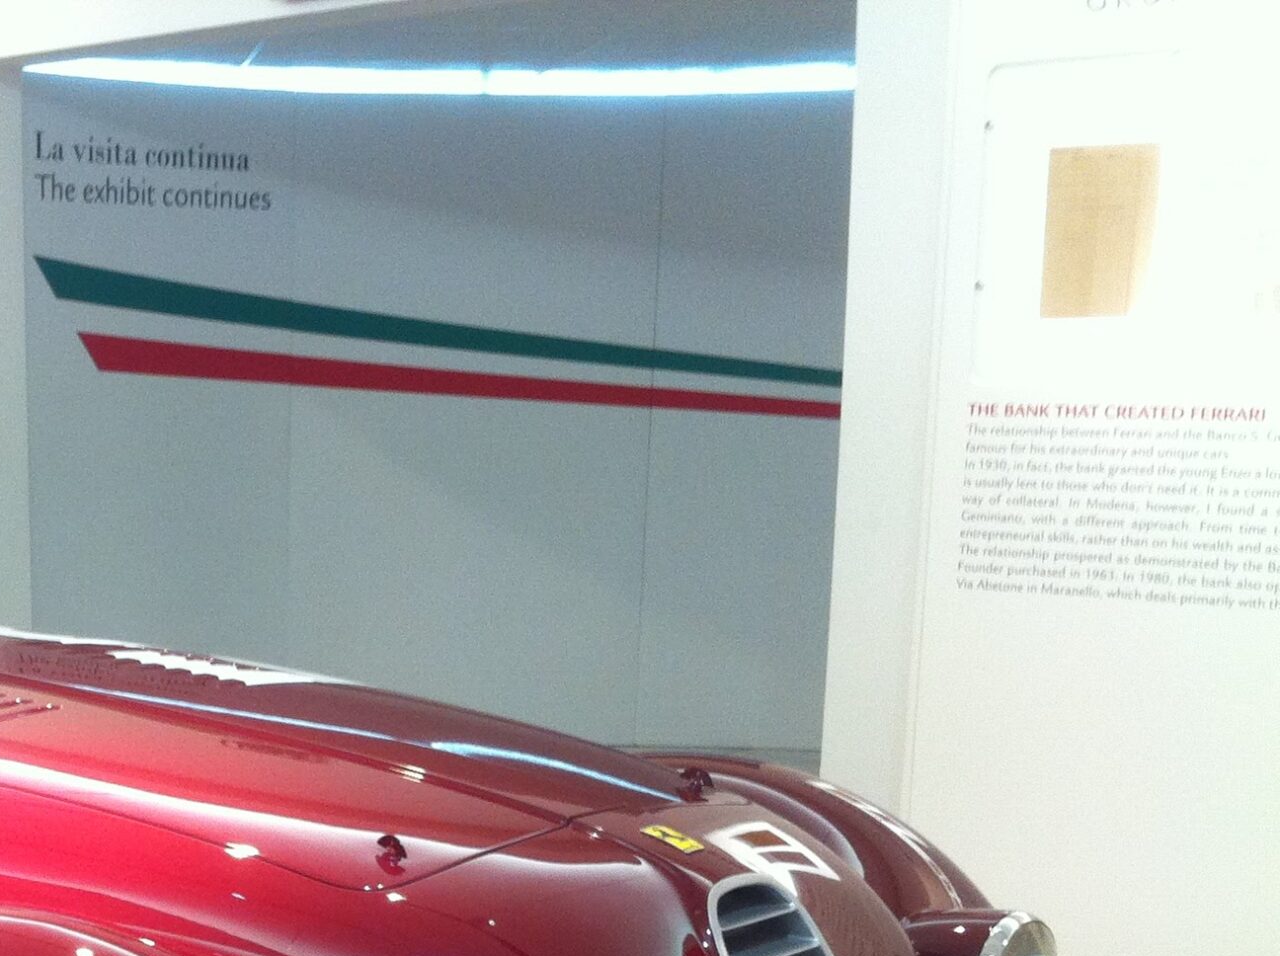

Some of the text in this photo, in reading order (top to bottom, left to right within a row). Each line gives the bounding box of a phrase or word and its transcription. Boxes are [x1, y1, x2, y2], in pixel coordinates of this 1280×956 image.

[33, 129, 251, 173] La visita continua
[34, 172, 272, 212] The exhibit continues
[967, 402, 1266, 422] THE BANK THAT CREATED FERRARI
[967, 422, 987, 437] The
[990, 426, 1058, 441] relationship
[1061, 427, 1109, 440] between
[1112, 427, 1152, 440] Ferrari
[1155, 429, 1180, 441] and
[1183, 429, 1202, 441] the
[965, 441, 1007, 455] famous
[1010, 442, 1026, 455] for
[1030, 442, 1046, 456] his
[1049, 444, 1127, 461] extraordinary
[1130, 446, 1154, 459] and
[1157, 449, 1200, 461] unique
[964, 459, 977, 471] In
[1054, 462, 1073, 473] the
[1076, 462, 1105, 473] bank
[1107, 464, 1154, 479] granted
[1157, 464, 1177, 477] the
[1179, 469, 1218, 482] young
[975, 478, 1013, 492] usually
[1016, 478, 1037, 490] lent
[1056, 480, 1089, 492] those
[1092, 482, 1118, 493] who
[1157, 483, 1186, 497] need
[962, 496, 984, 508] way
[988, 494, 1002, 506] of
[1068, 498, 1081, 509] In
[1217, 502, 1255, 517] found
[1031, 513, 1056, 525] with
[1075, 514, 1125, 528] different
[1199, 519, 1233, 534] From
[1239, 524, 1268, 536] time
[959, 529, 1045, 543] entrepreneurial
[1081, 534, 1118, 546] rather
[1120, 536, 1148, 547] than
[1151, 539, 1168, 549] on
[1171, 538, 1188, 551] his
[1192, 539, 1233, 552] wealth
[1237, 542, 1262, 553] and
[959, 542, 1263, 573] The relationship prospered as demonstrated by the
[957, 559, 1004, 575] Founder
[1006, 564, 1067, 578] purchased
[1177, 573, 1198, 586] the
[1200, 574, 1233, 589] bank
[1236, 577, 1263, 591] also
[956, 575, 974, 590] Via
[976, 578, 1024, 593] Abetone
[1106, 588, 1142, 601] which
[1144, 589, 1177, 603] deals
[1179, 594, 1235, 610] primarily
[1238, 597, 1266, 609] with
